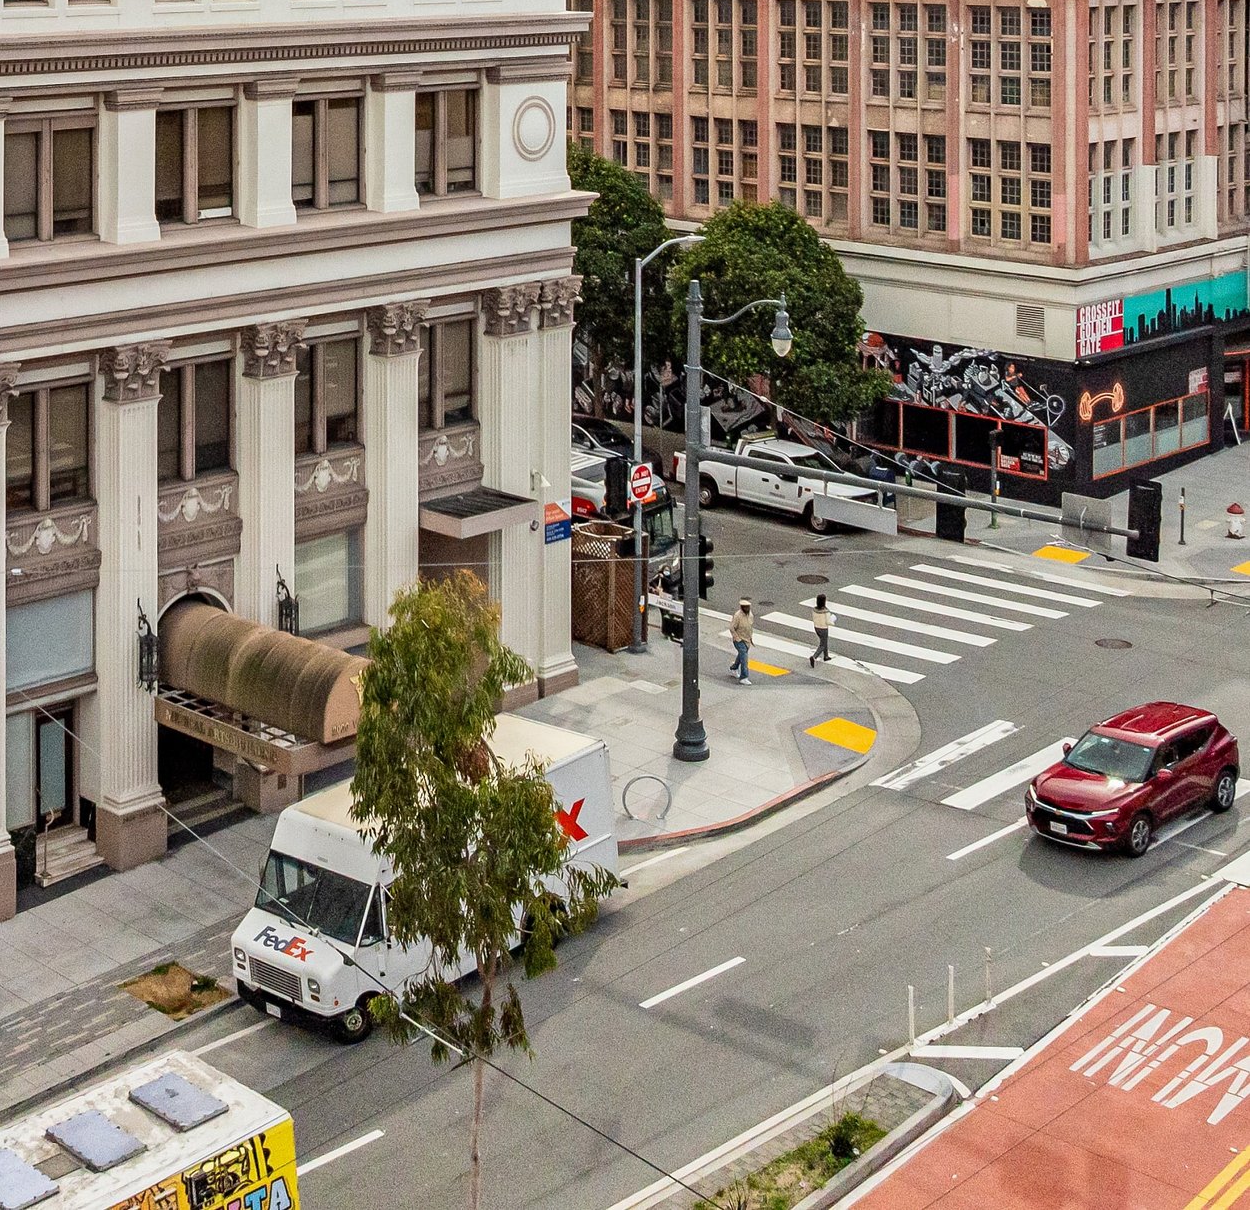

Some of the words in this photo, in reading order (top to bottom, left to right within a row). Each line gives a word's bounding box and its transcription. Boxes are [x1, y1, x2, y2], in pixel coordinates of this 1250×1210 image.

[1079, 299, 1121, 324] CROSSFIT
[1079, 317, 1113, 340] GOLDEN
[1079, 338, 1101, 356] GATE
[253, 925, 314, 962] FedEx
